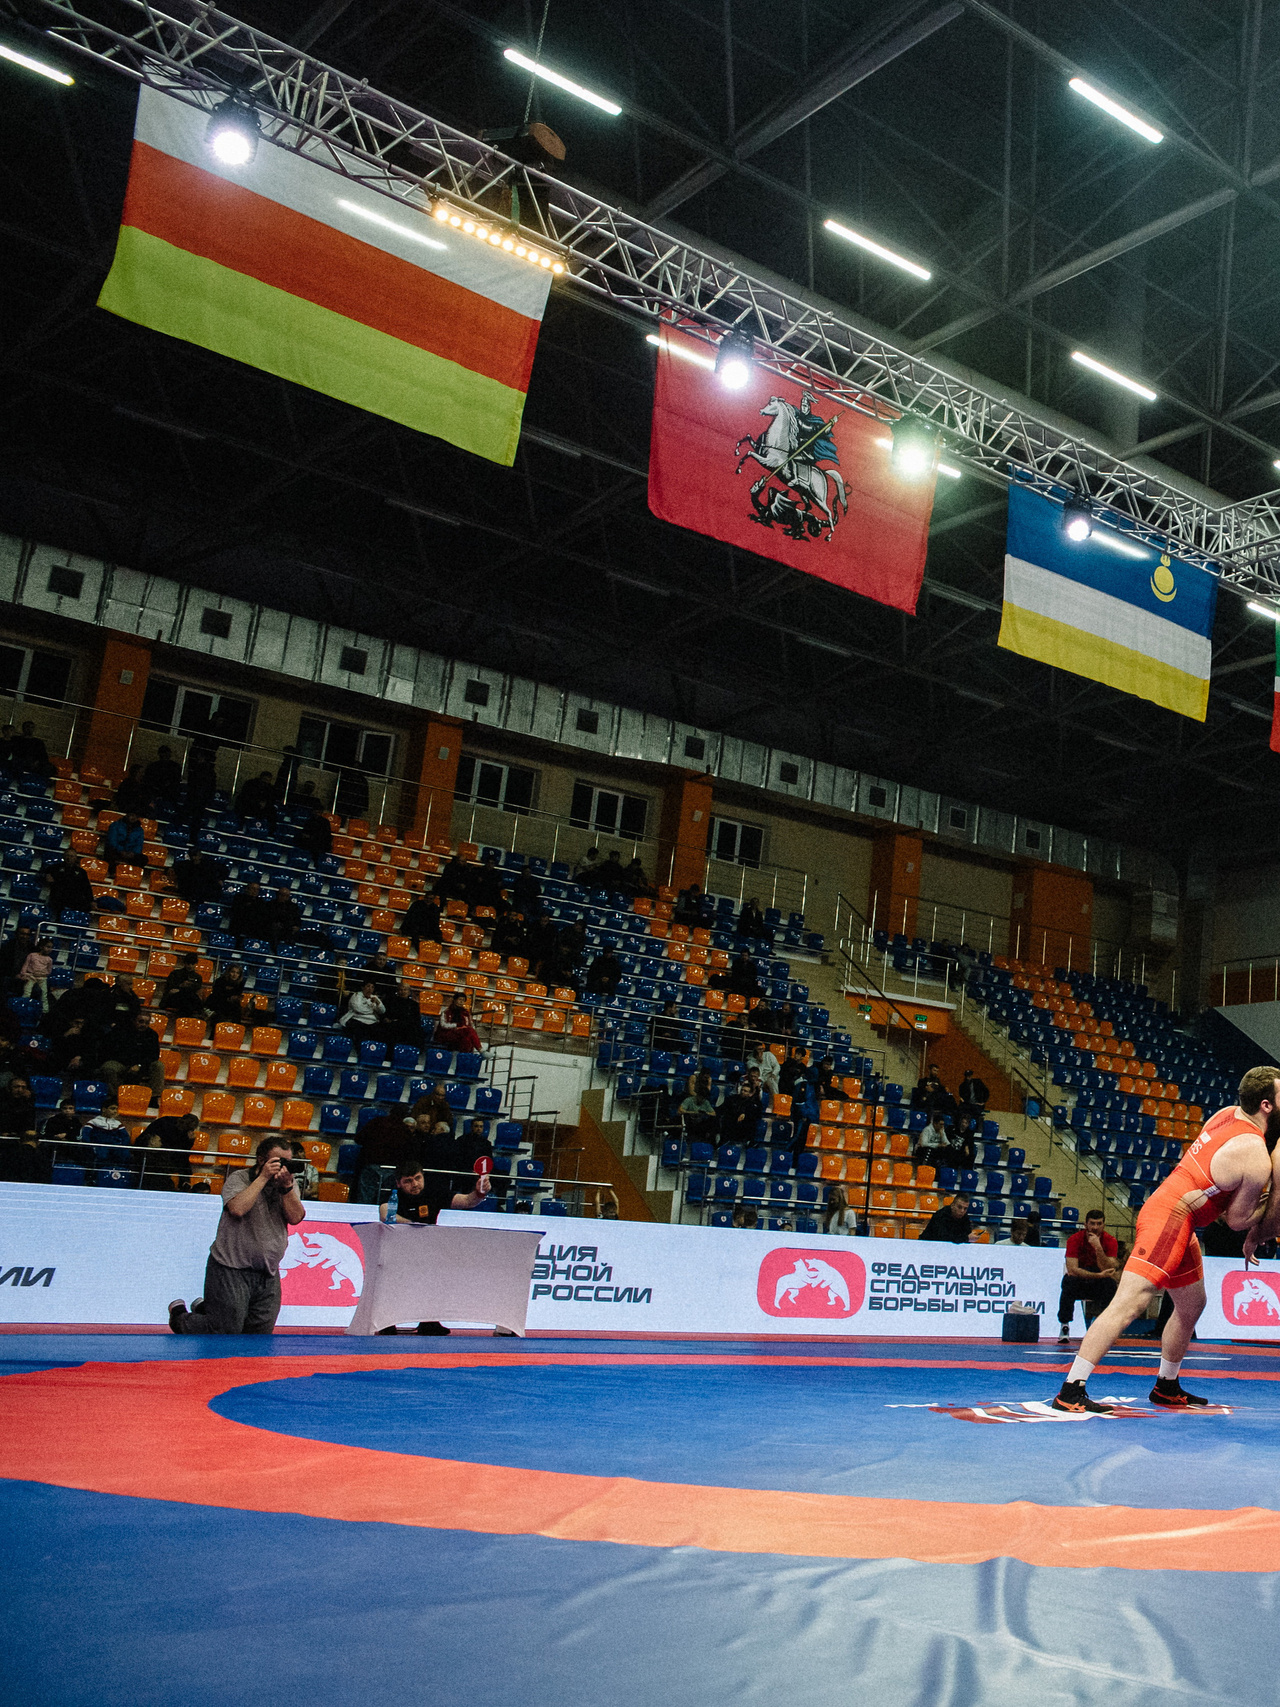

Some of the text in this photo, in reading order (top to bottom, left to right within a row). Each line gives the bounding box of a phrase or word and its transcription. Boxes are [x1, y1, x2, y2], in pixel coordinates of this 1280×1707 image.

[481, 1158, 488, 1174] 1
[535, 1244, 598, 1264] ЦИЯ
[0, 1266, 56, 1287] ИИ
[531, 1262, 613, 1282] ВНОЙ
[871, 1262, 1004, 1282] ФЕДЕРАЦИЯ
[531, 1284, 653, 1304] РОССИИ
[870, 1279, 1016, 1298] СПОРТИВНОЙ
[868, 1296, 958, 1313] БОРЬБЫ
